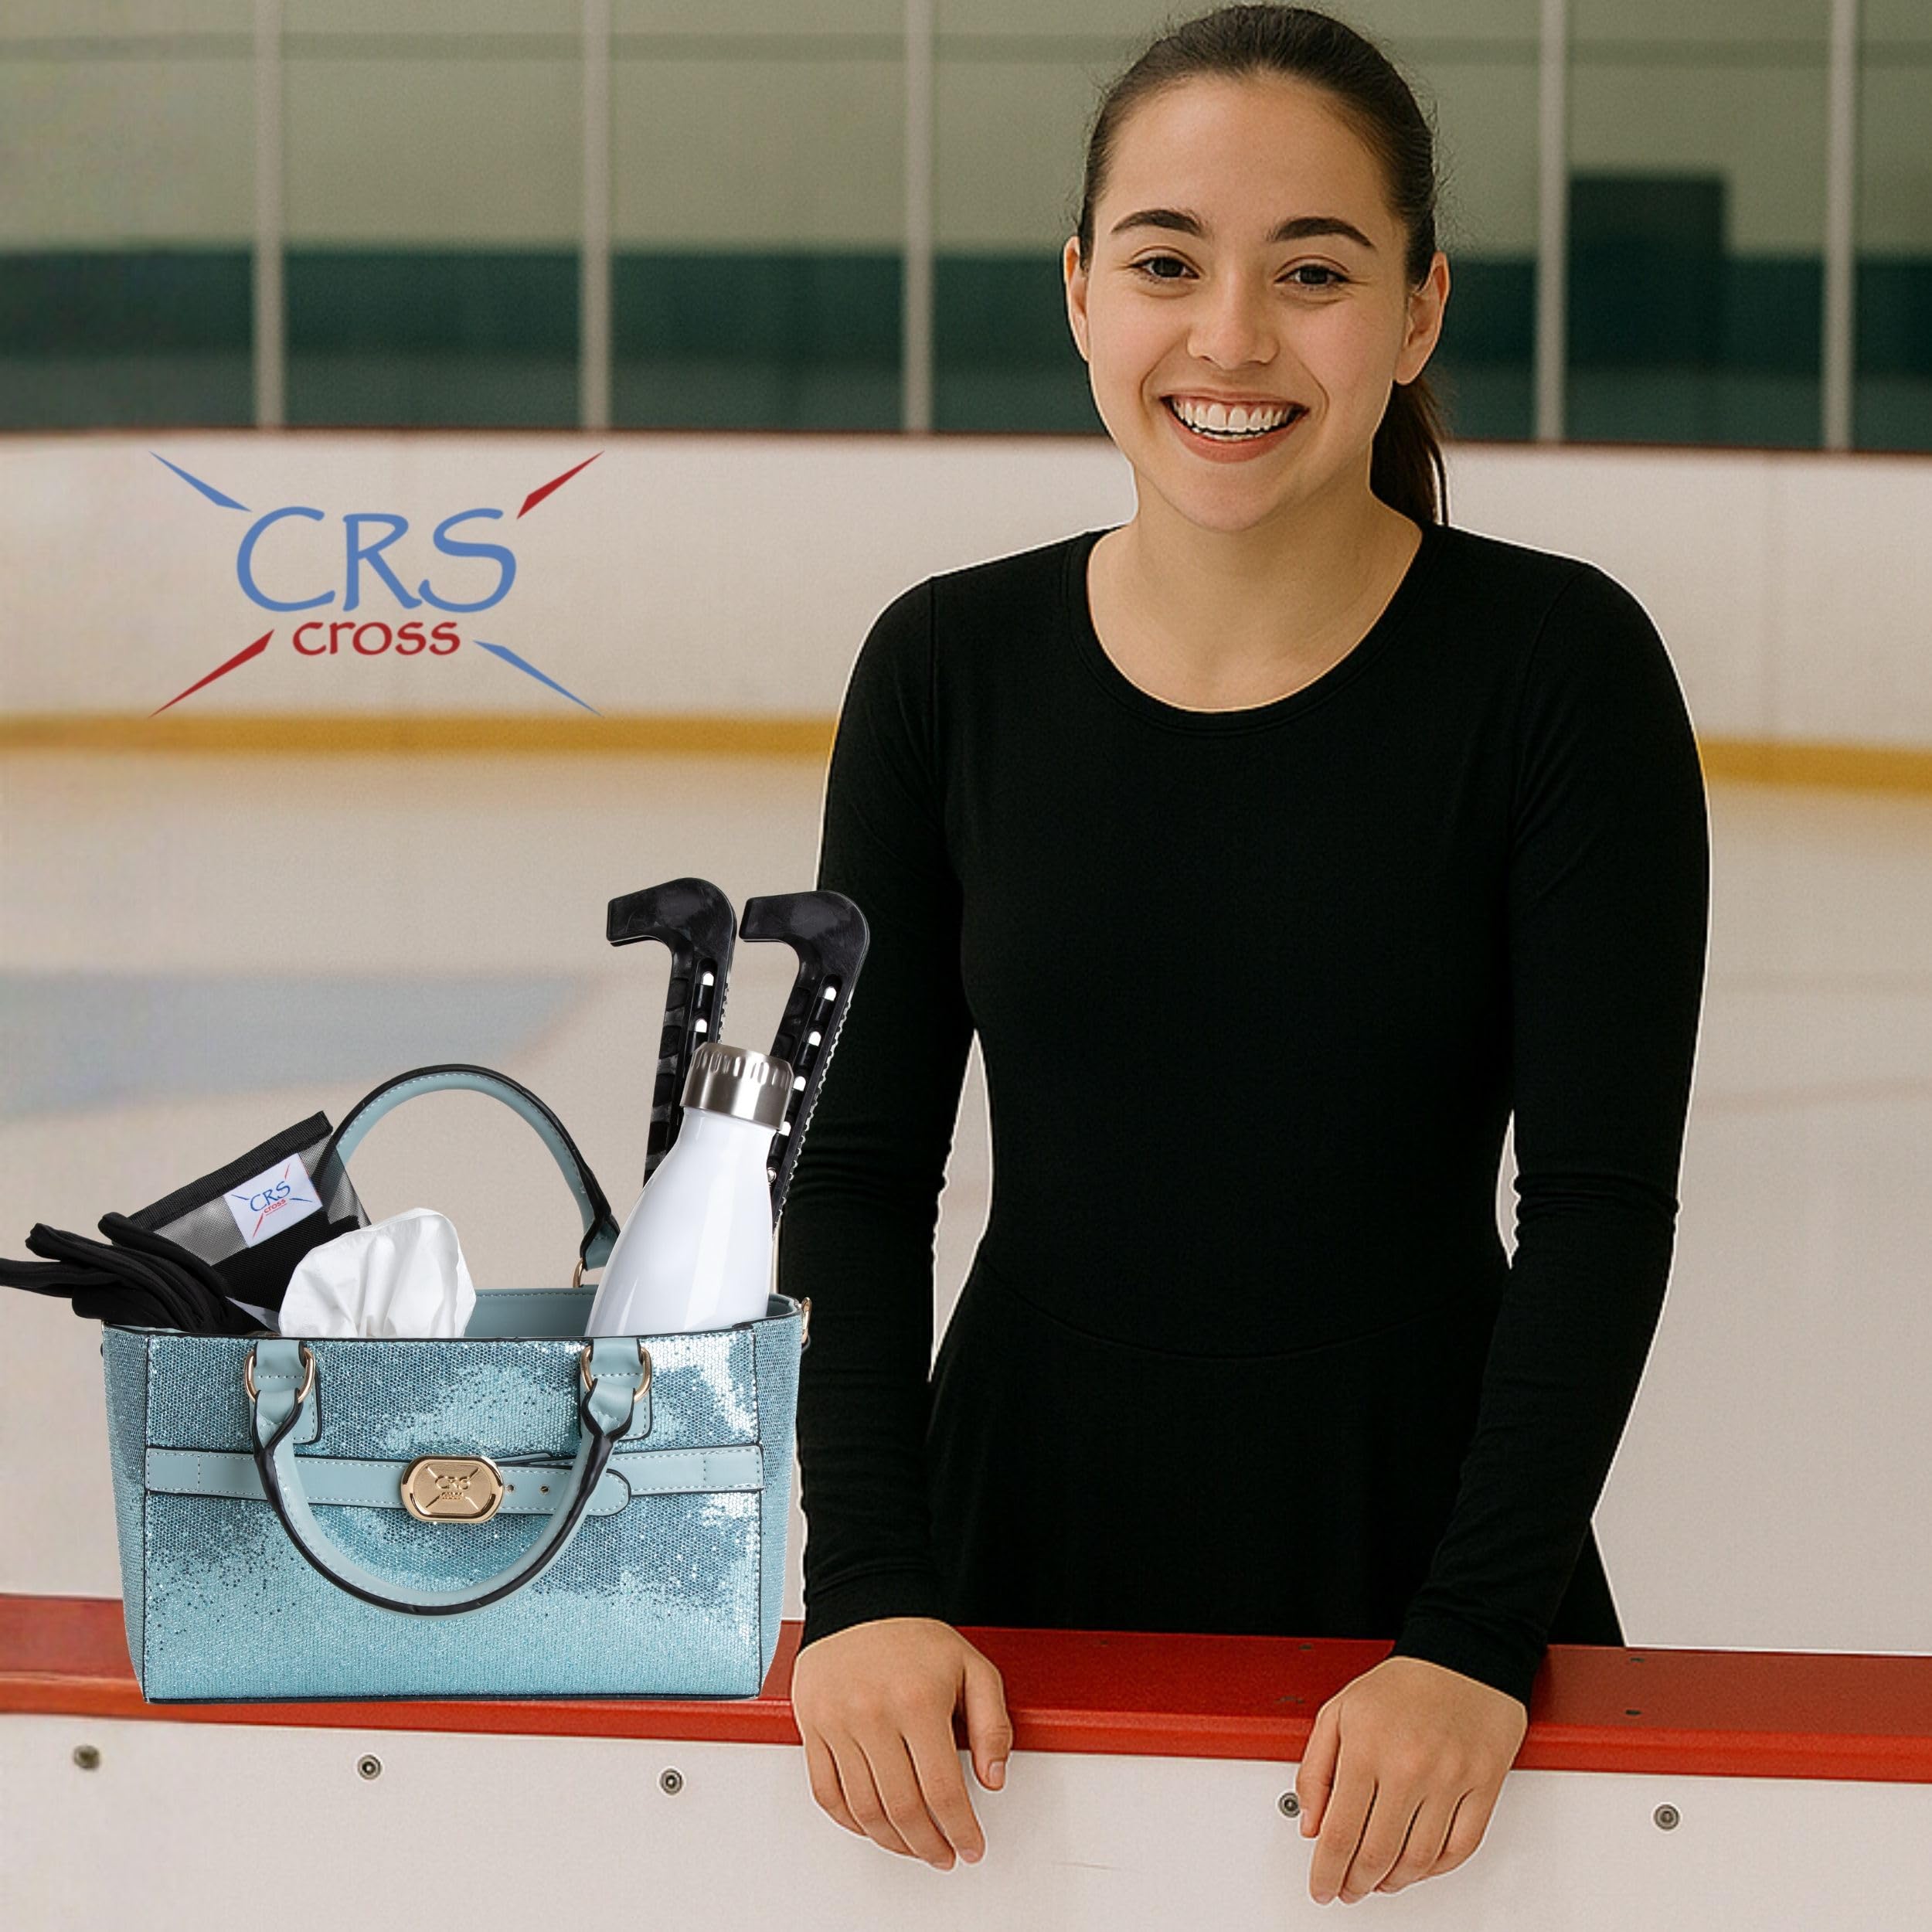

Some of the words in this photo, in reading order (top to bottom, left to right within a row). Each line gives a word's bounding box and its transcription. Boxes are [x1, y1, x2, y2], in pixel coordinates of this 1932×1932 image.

[250, 1181, 291, 1211] CRS
[264, 1199, 286, 1213] cross
[435, 1475, 471, 1490] CRS
